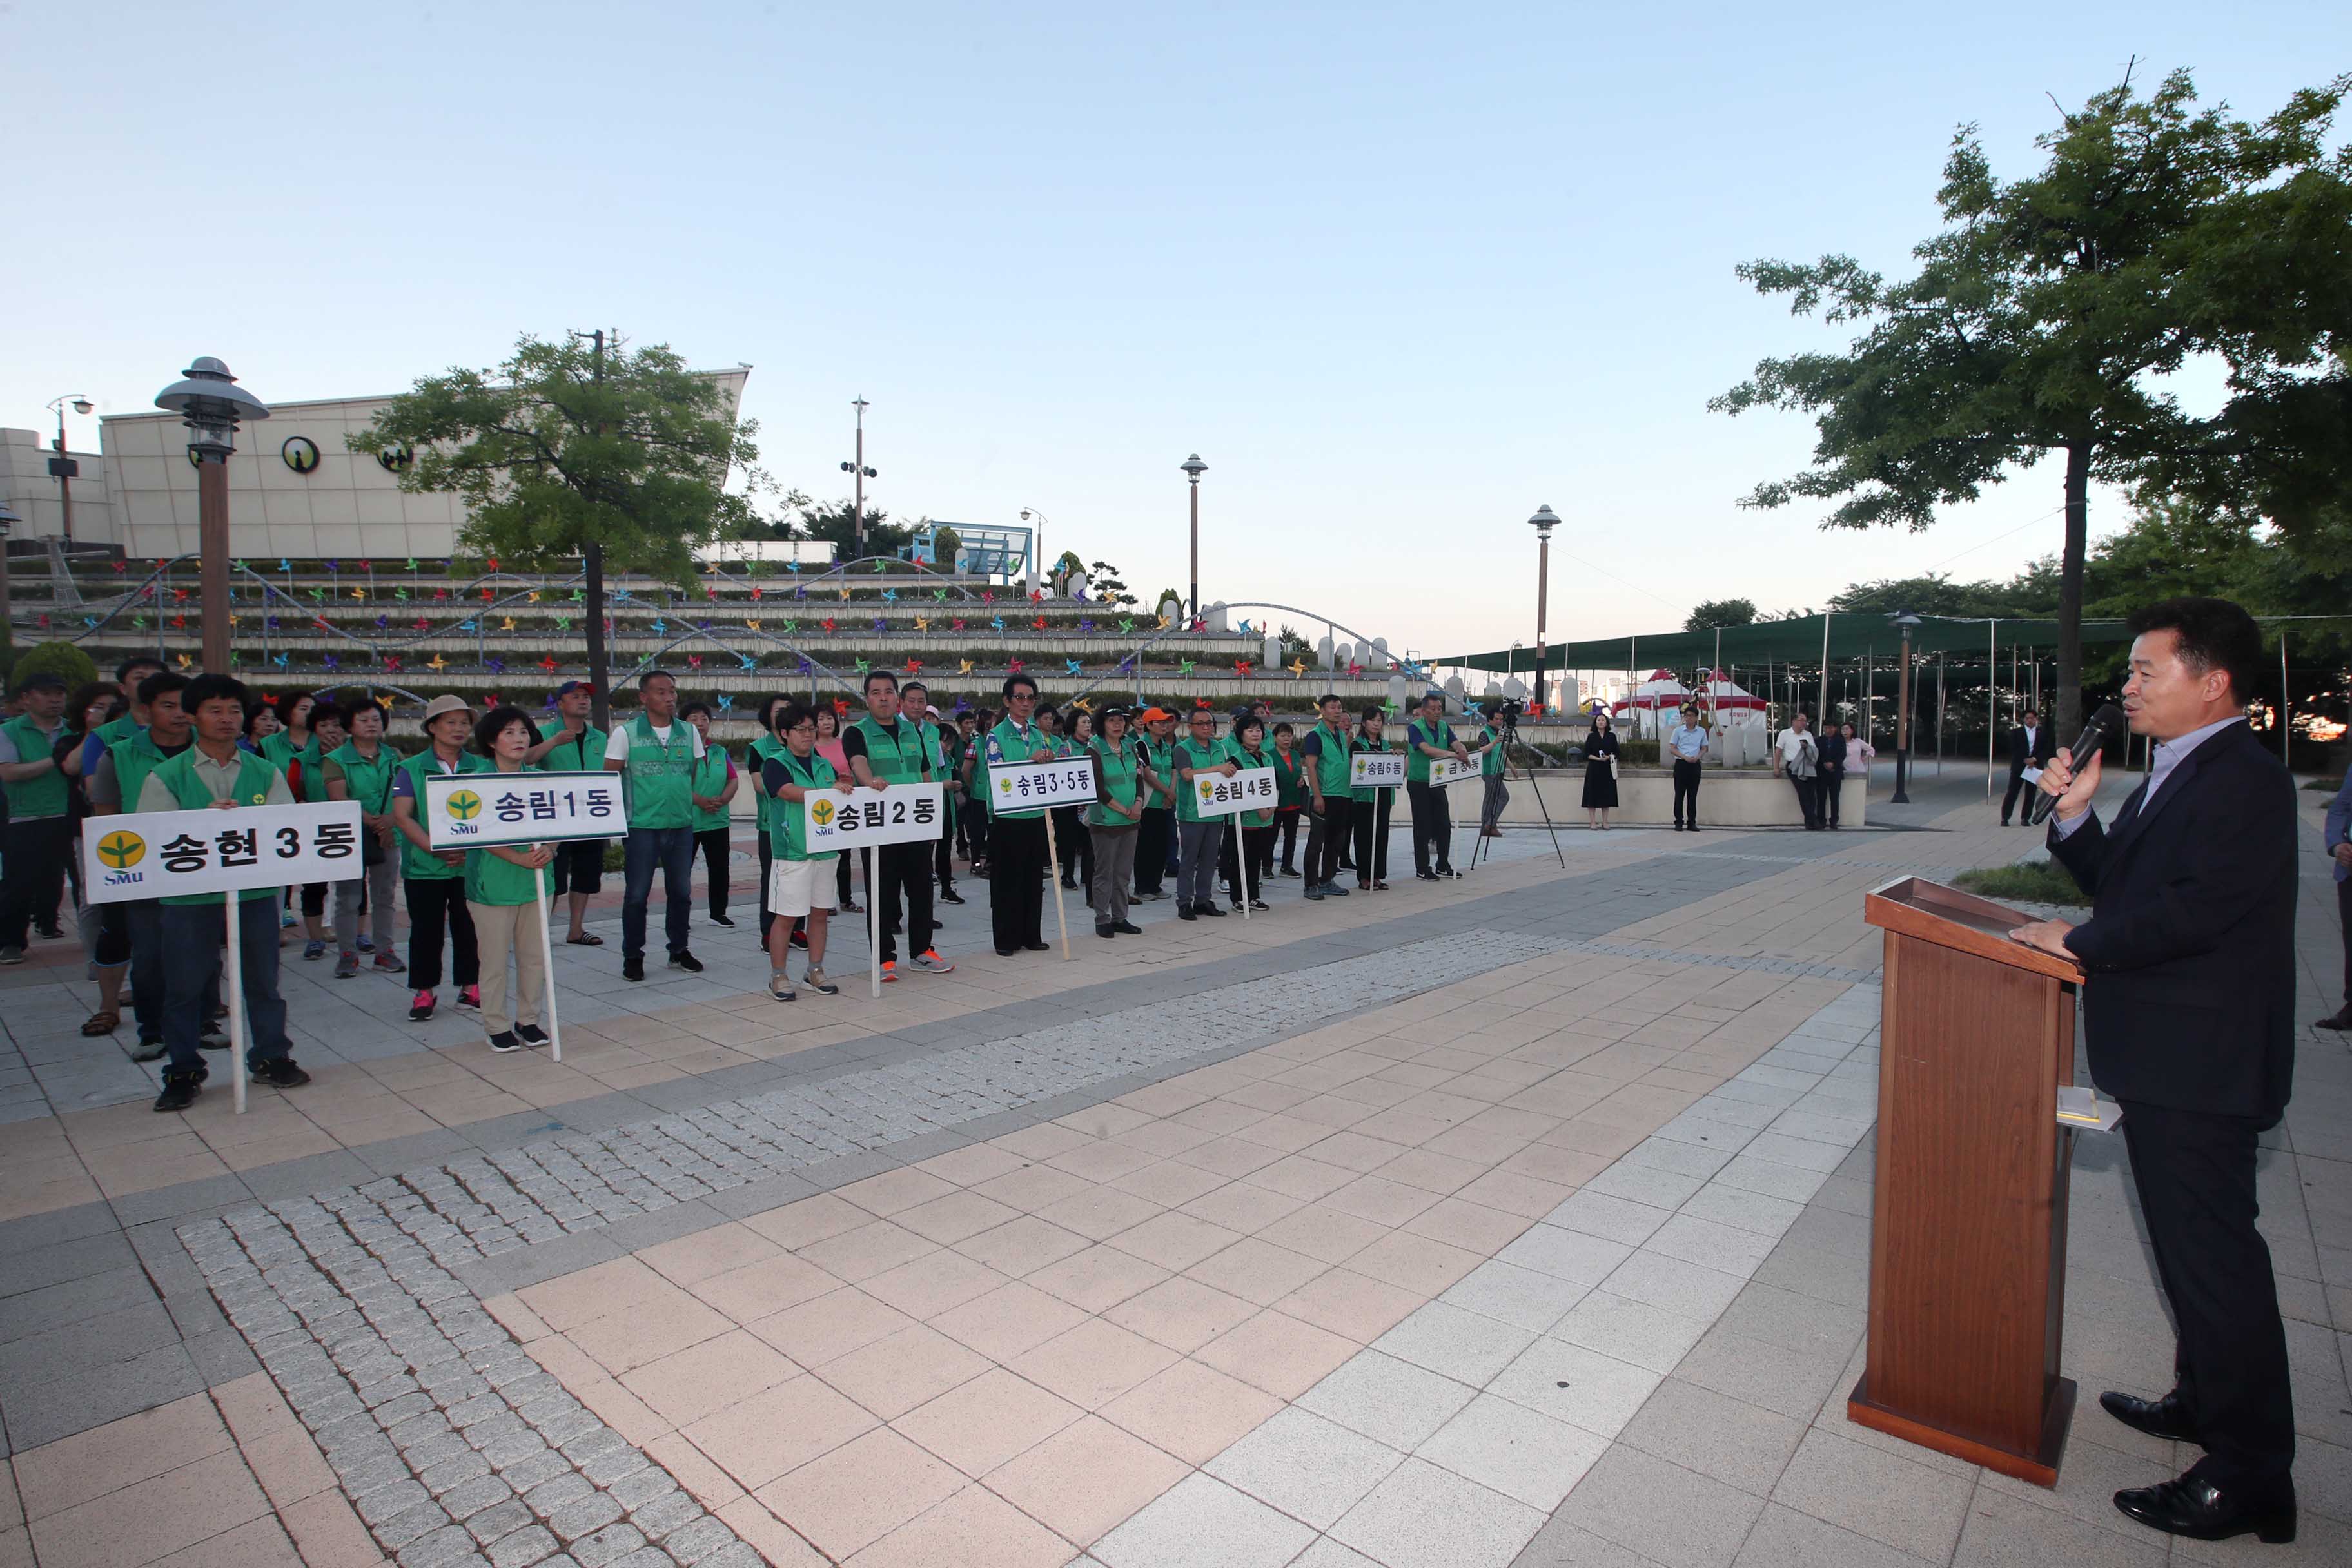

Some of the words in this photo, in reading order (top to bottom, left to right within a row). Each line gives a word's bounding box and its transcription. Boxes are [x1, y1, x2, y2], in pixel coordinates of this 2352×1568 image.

[1367, 761, 1401, 775] 송림6동
[495, 789, 611, 822] 송림1동
[451, 825, 478, 835] SMU
[815, 828, 834, 837] SMU
[104, 872, 143, 886] SMU
